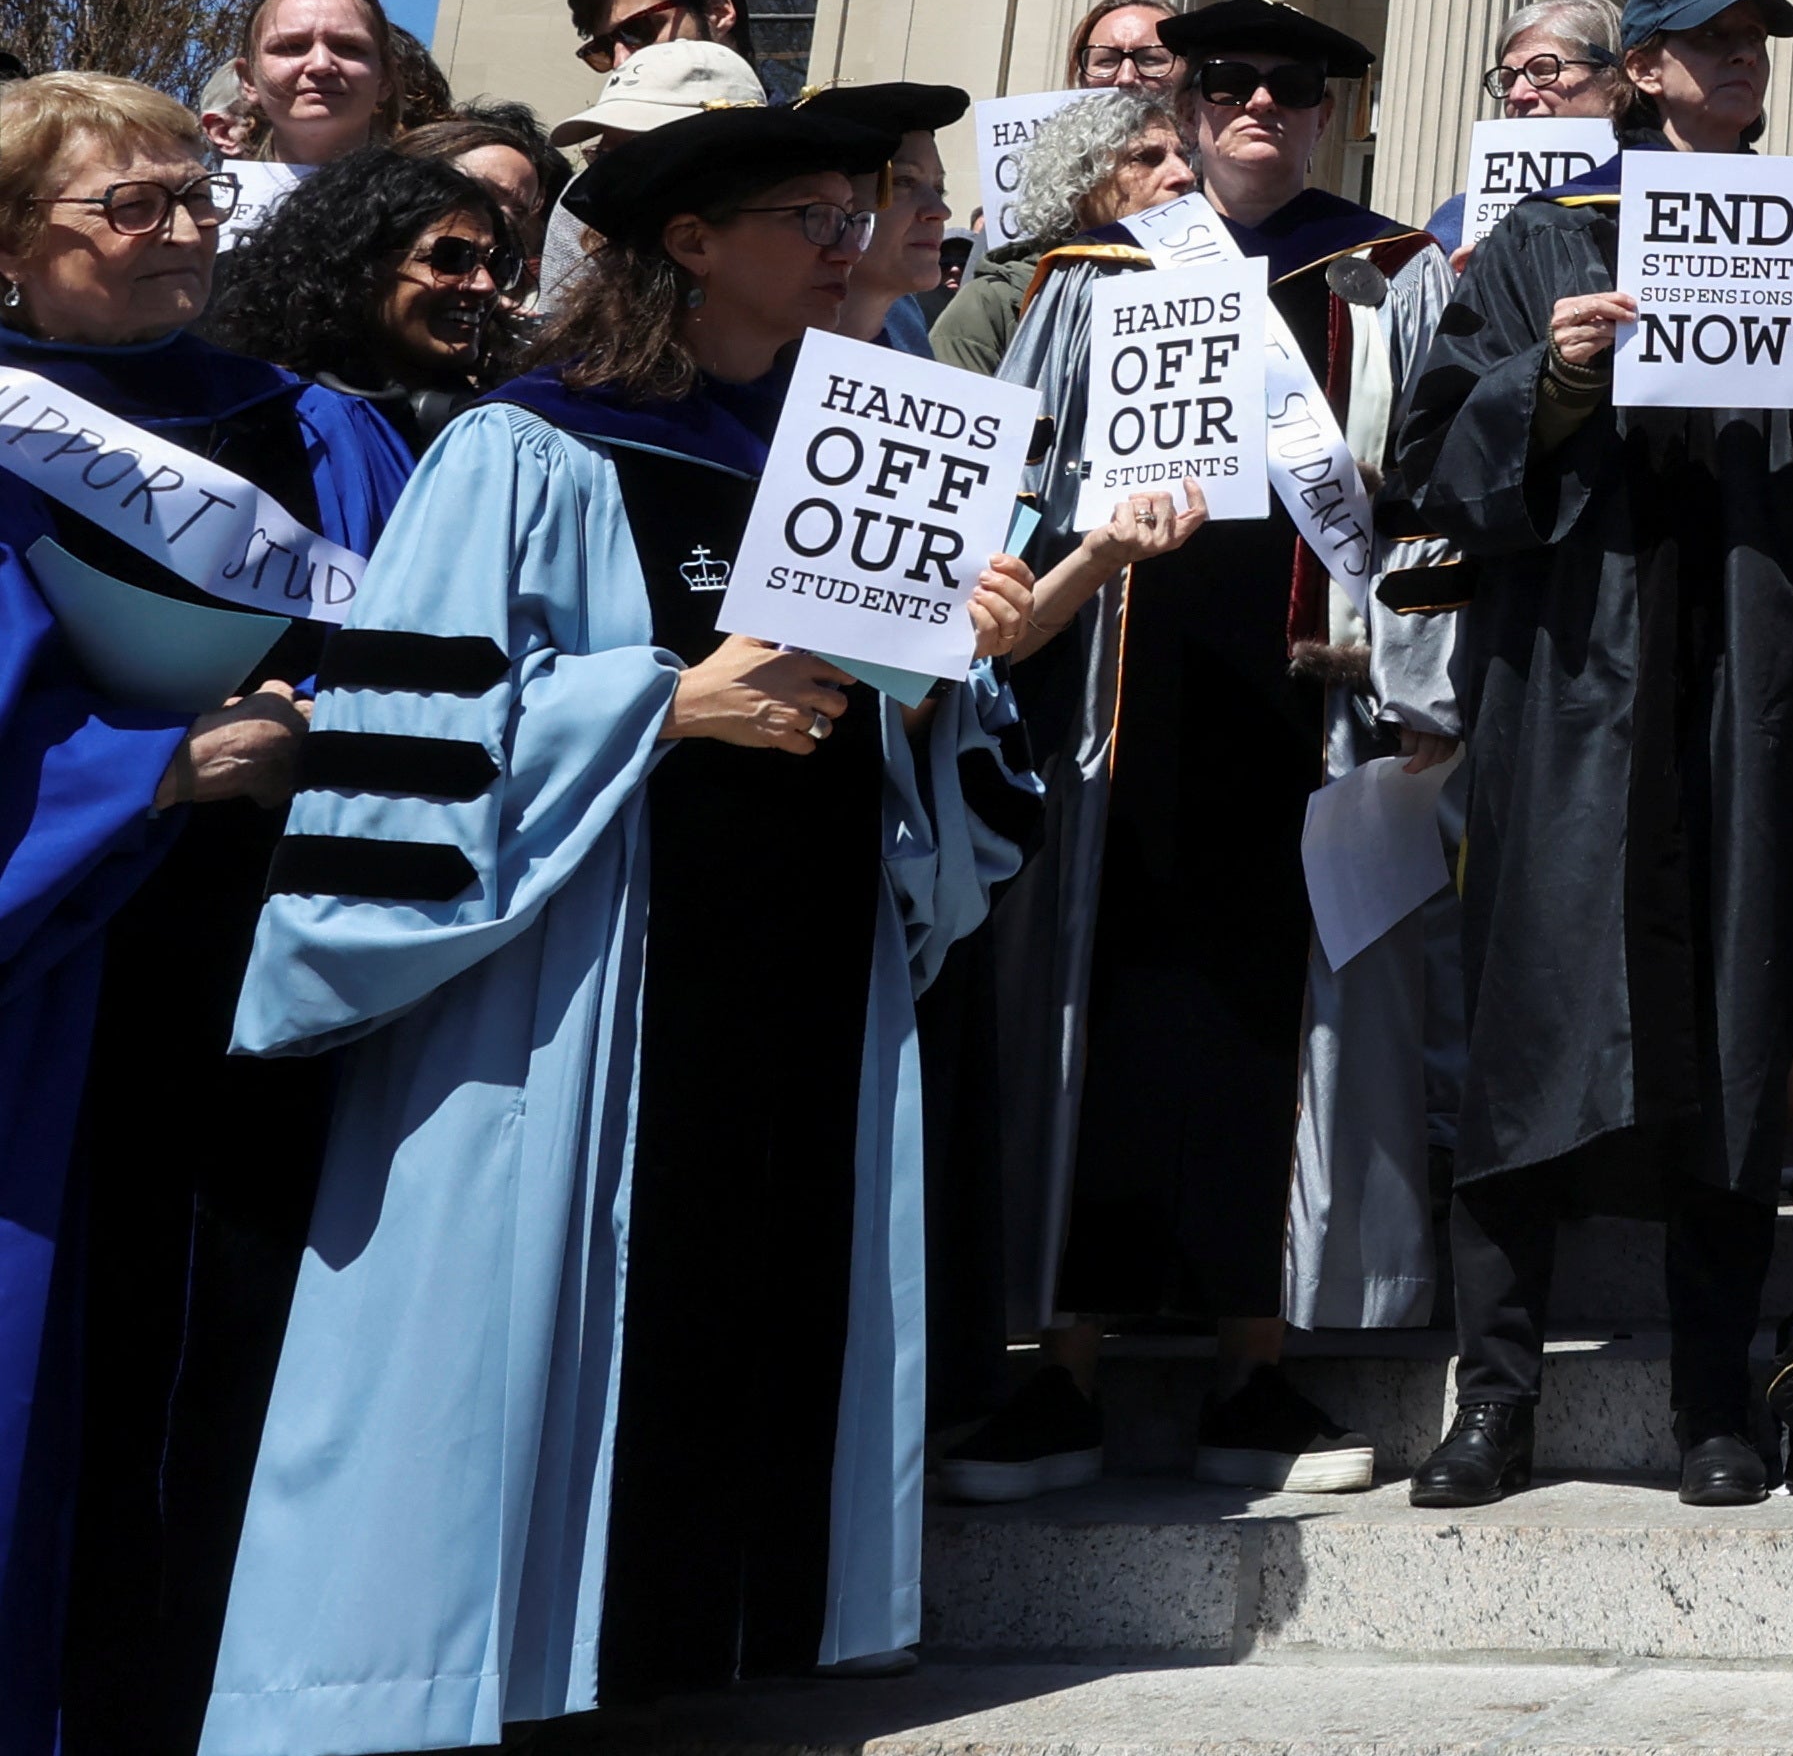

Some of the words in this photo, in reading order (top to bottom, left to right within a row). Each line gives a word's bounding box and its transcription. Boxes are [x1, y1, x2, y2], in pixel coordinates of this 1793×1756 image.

[1112, 292, 1241, 337] HANDS
[1640, 287, 1793, 307] SUSPENSIONS
[1111, 333, 1240, 396] OFF
[1638, 314, 1793, 366] NOW
[820, 374, 1001, 450] HANDS
[1108, 396, 1238, 456] OUR
[806, 426, 990, 515] OFF
[1104, 456, 1239, 489] STUDENTS
[784, 497, 966, 589] OUR
[766, 567, 953, 625] STUDENTS
